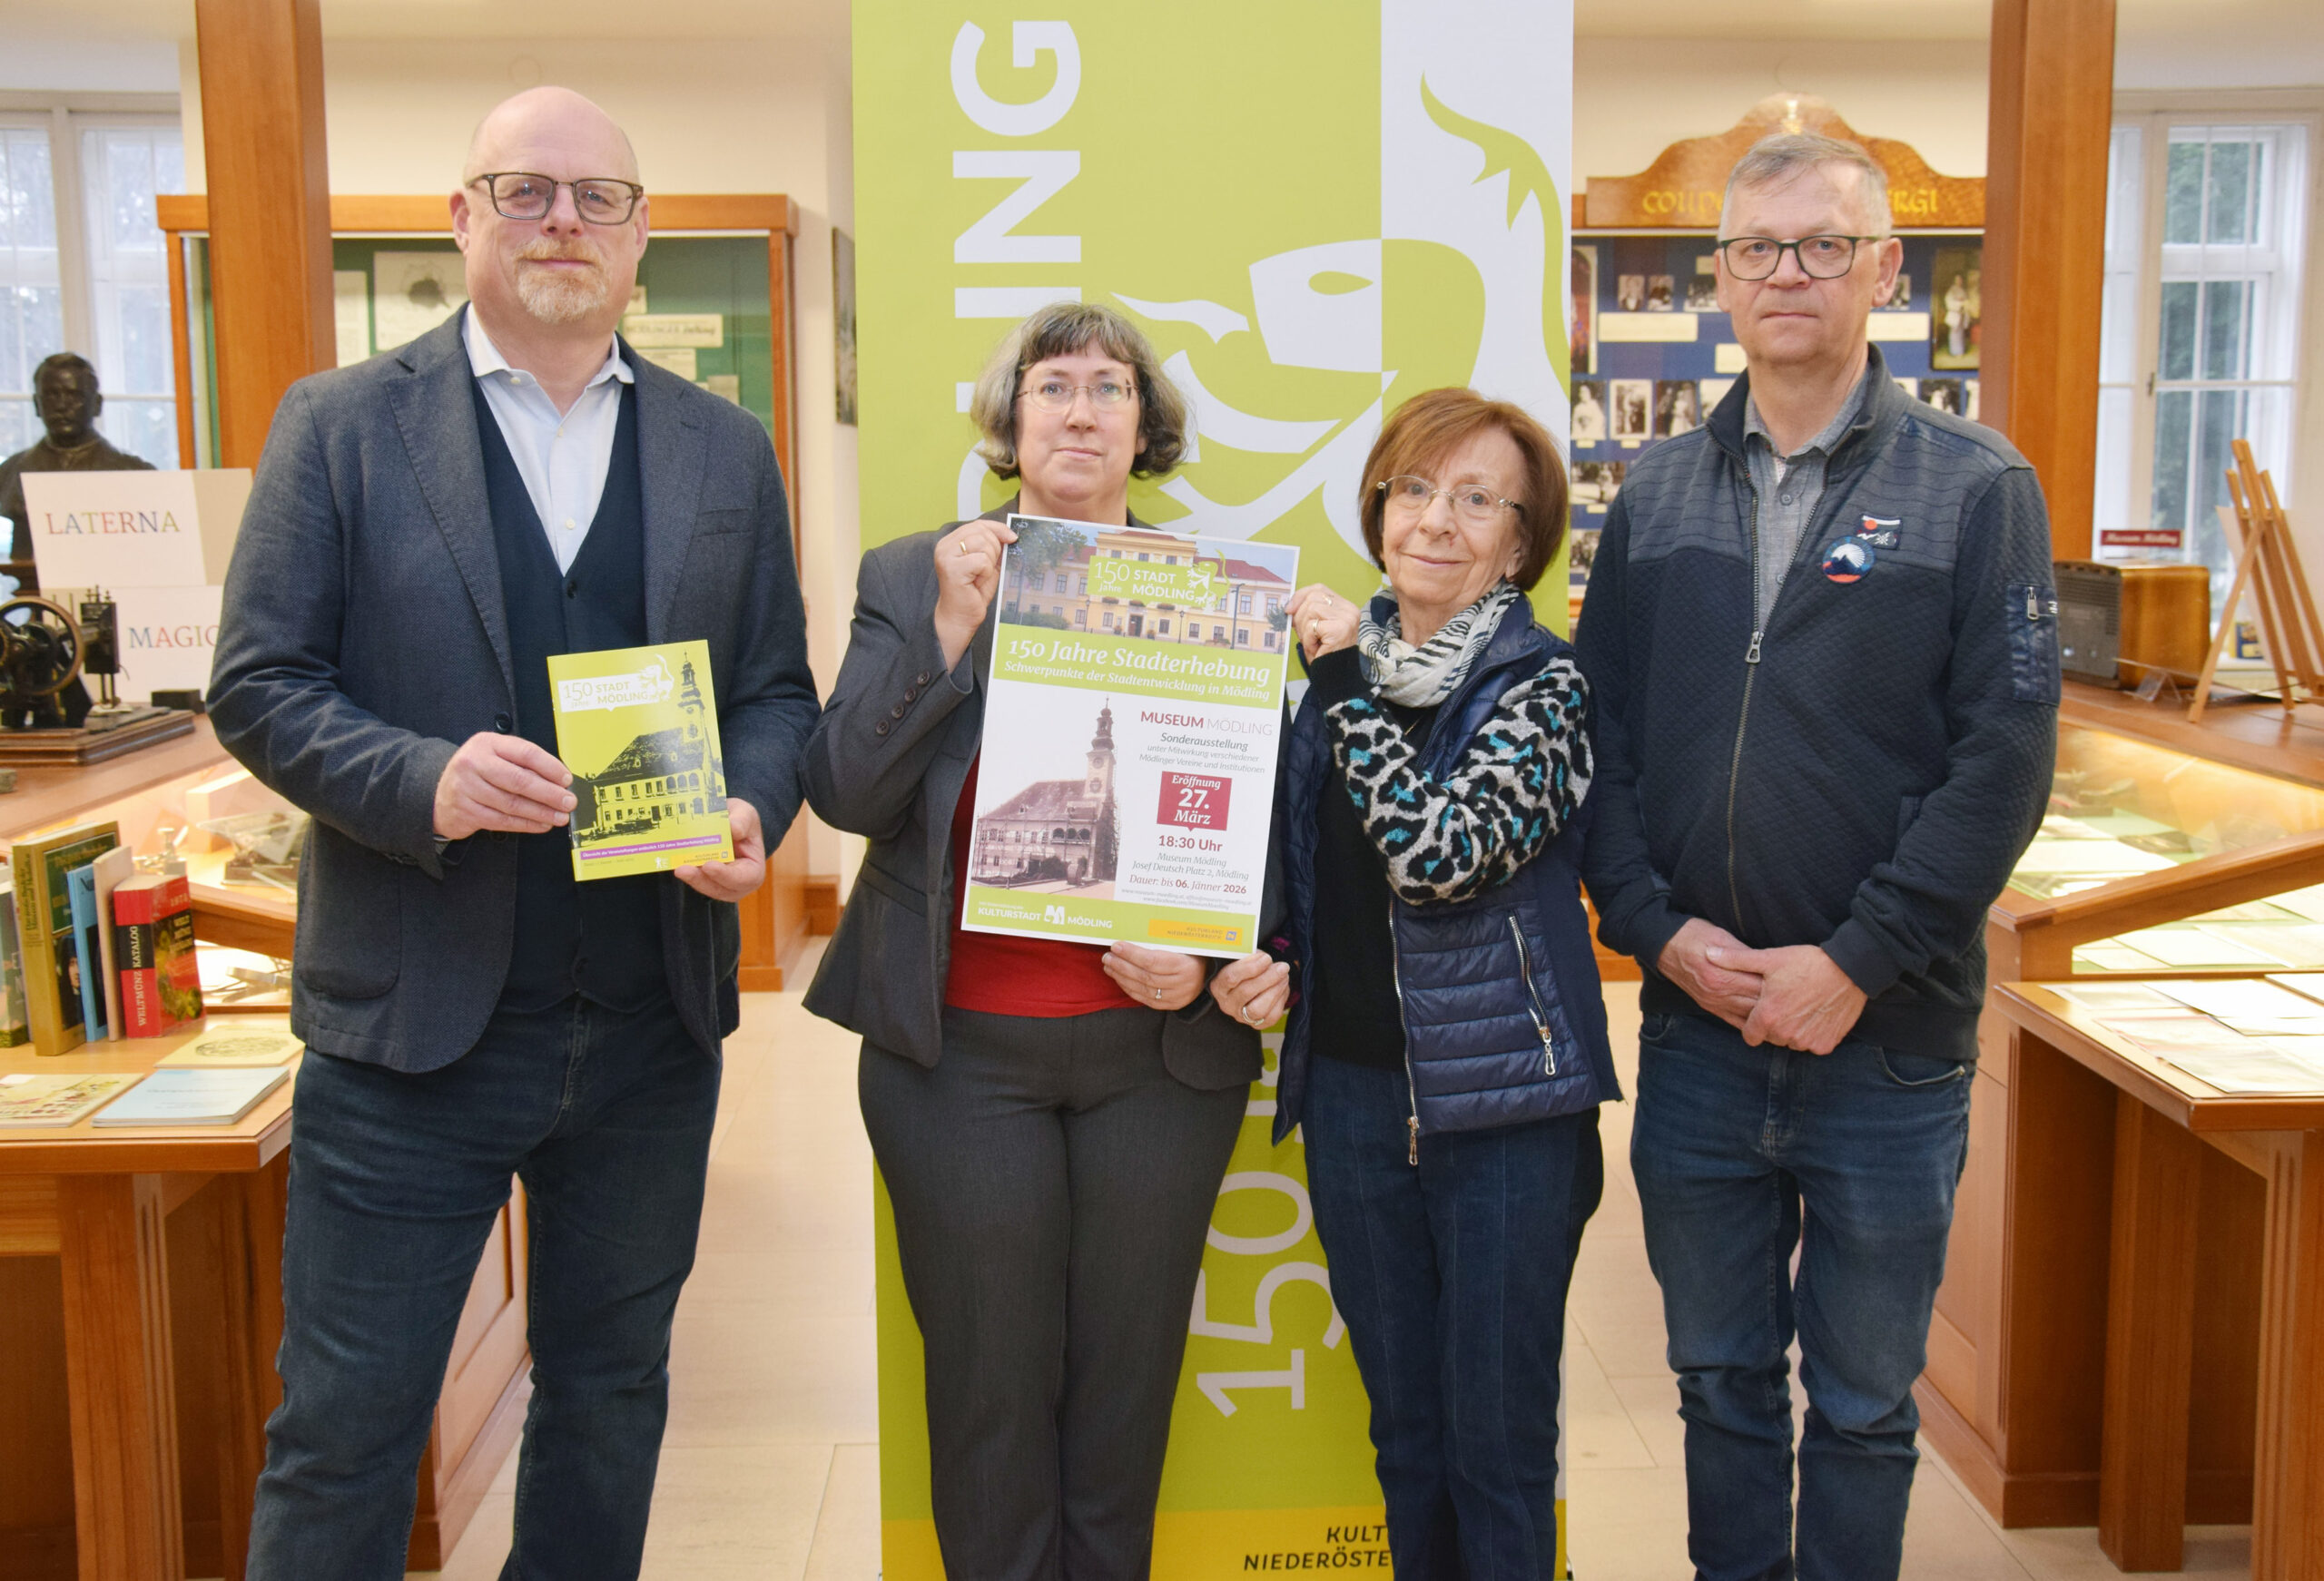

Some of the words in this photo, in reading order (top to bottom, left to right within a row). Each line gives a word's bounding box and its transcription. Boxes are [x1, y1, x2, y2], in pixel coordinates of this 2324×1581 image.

[45, 511, 181, 535] LATERNA
[1095, 561, 1129, 584] 150
[1134, 569, 1177, 584] STADT
[1098, 582, 1122, 593] Jahre
[1132, 583, 1195, 601] MÖDLING
[1009, 640, 1045, 659] 150
[1048, 640, 1108, 664] Jahre
[1112, 647, 1270, 687] Stadterhebung
[1005, 660, 1084, 679] Schwerpunkte
[1087, 670, 1106, 682] der
[1108, 673, 1206, 695] Stadtentwicklung
[1208, 682, 1219, 693] in
[1222, 684, 1269, 702] Mödling
[564, 682, 593, 702] 150
[596, 681, 631, 693] STADT
[597, 691, 648, 704] MÖDLING
[1140, 711, 1204, 729] MUSEUM
[1206, 717, 1273, 736] MÖDLING
[1160, 732, 1249, 751] Sonderausstellung
[1147, 745, 1167, 753] unter
[1168, 745, 1209, 759] Mitwirkung
[1210, 751, 1259, 761] verschiedener
[1139, 754, 1175, 765] Mödlinger
[1177, 758, 1203, 768] Vereine
[1204, 761, 1218, 769] und
[1219, 762, 1265, 773] Institutionen
[1172, 774, 1221, 790] Eröffnung
[1178, 788, 1209, 810] 27.
[1174, 810, 1211, 825] März
[1158, 835, 1195, 849] 18:30
[1198, 839, 1223, 851] Uhr
[1132, 861, 1152, 870] Josef
[1153, 862, 1184, 873] Deutsch
[1185, 866, 1206, 876] Platz
[1216, 869, 1249, 880] Mödling
[1157, 852, 1192, 863] Museum
[1194, 856, 1226, 869] Mödling
[1129, 874, 1158, 886] Dauer:
[1161, 879, 1174, 887] bis
[1176, 879, 1189, 889] 06.
[1191, 880, 1221, 891] Jänner
[1223, 884, 1246, 894] 2026
[978, 907, 1041, 921] KULTURSTADT
[1068, 916, 1112, 928] MÖDLING
[131, 926, 142, 968] KATALOG
[1189, 1171, 1346, 1418] 150
[1326, 1525, 1389, 1544] KULT
[1244, 1546, 1391, 1571] NIEDERÖSTE
